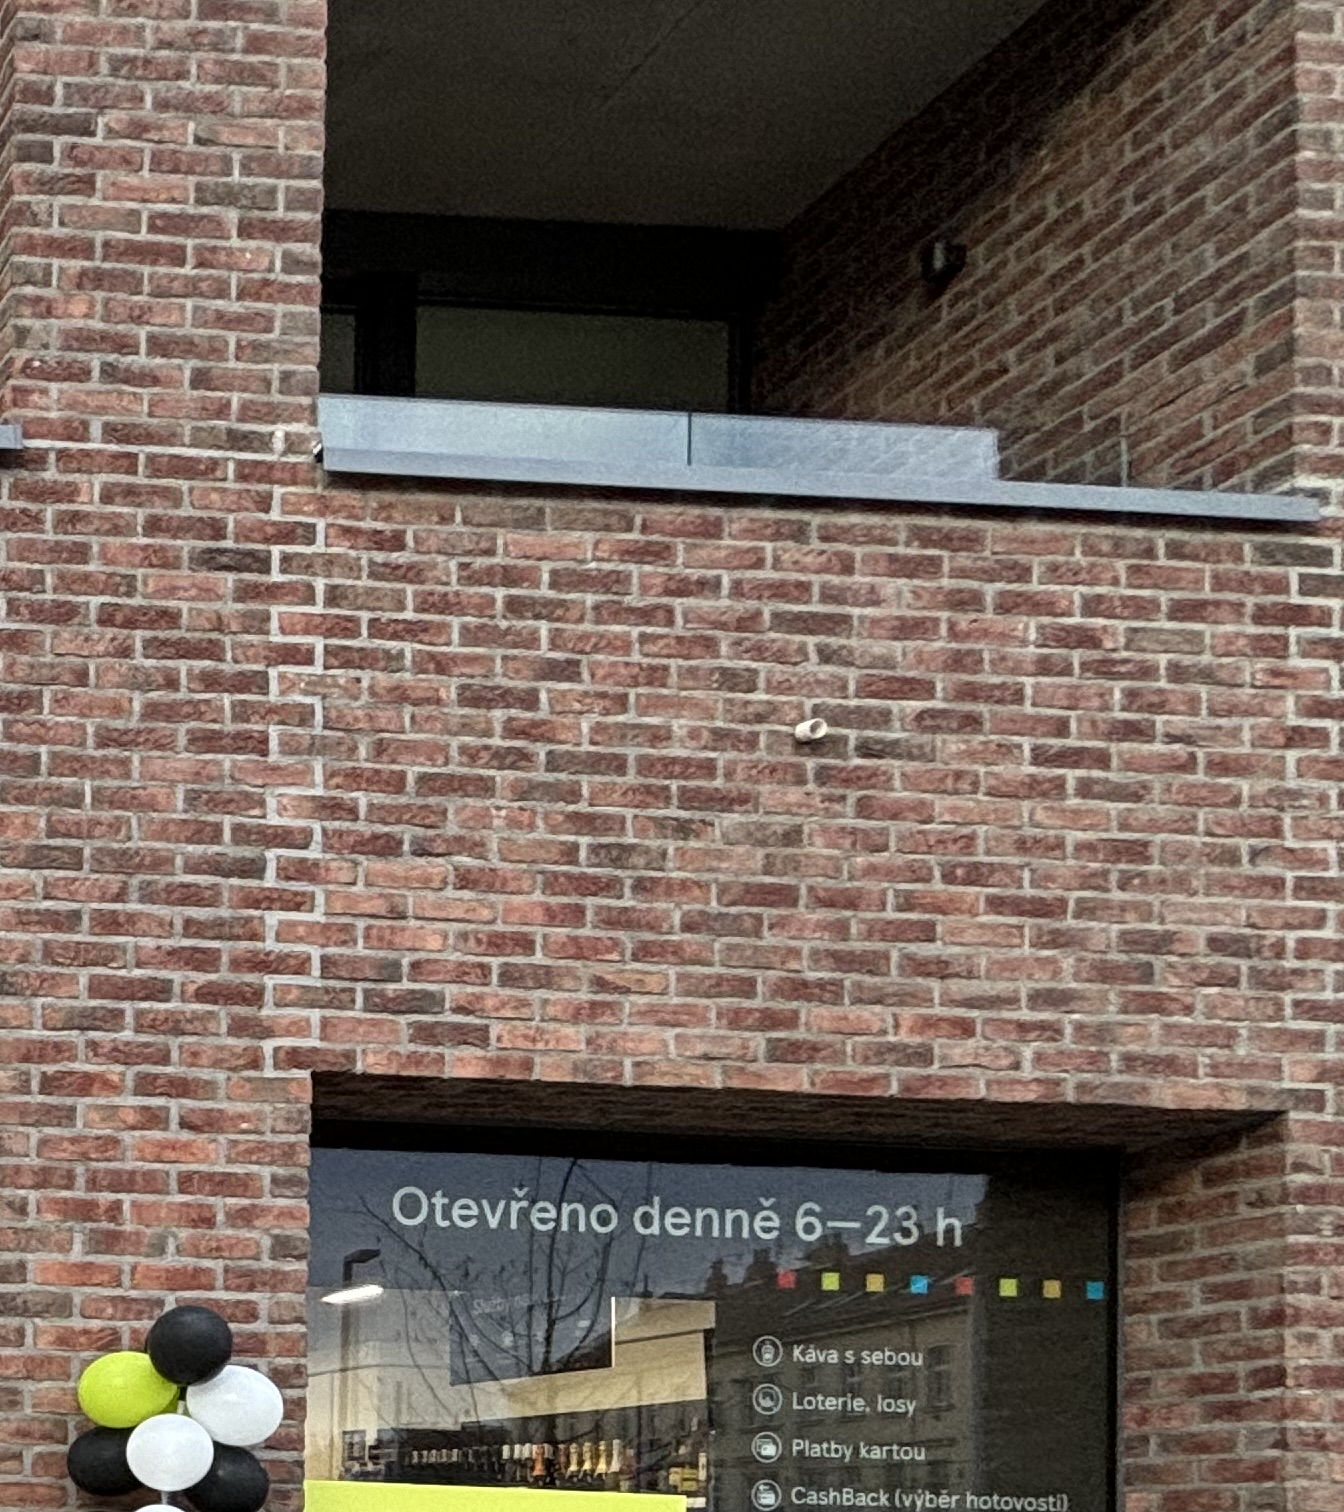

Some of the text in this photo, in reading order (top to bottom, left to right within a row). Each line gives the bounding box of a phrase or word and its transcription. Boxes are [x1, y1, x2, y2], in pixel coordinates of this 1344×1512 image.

[392, 1186, 619, 1234] Otevřeno
[632, 1196, 780, 1240] denně
[935, 1207, 963, 1247] h
[792, 1344, 924, 1366] Káva s sebou
[877, 1393, 916, 1417] losy
[792, 1439, 926, 1462] Platby kartou
[790, 1486, 1069, 1512] CashBack (výběr hotovosti)
